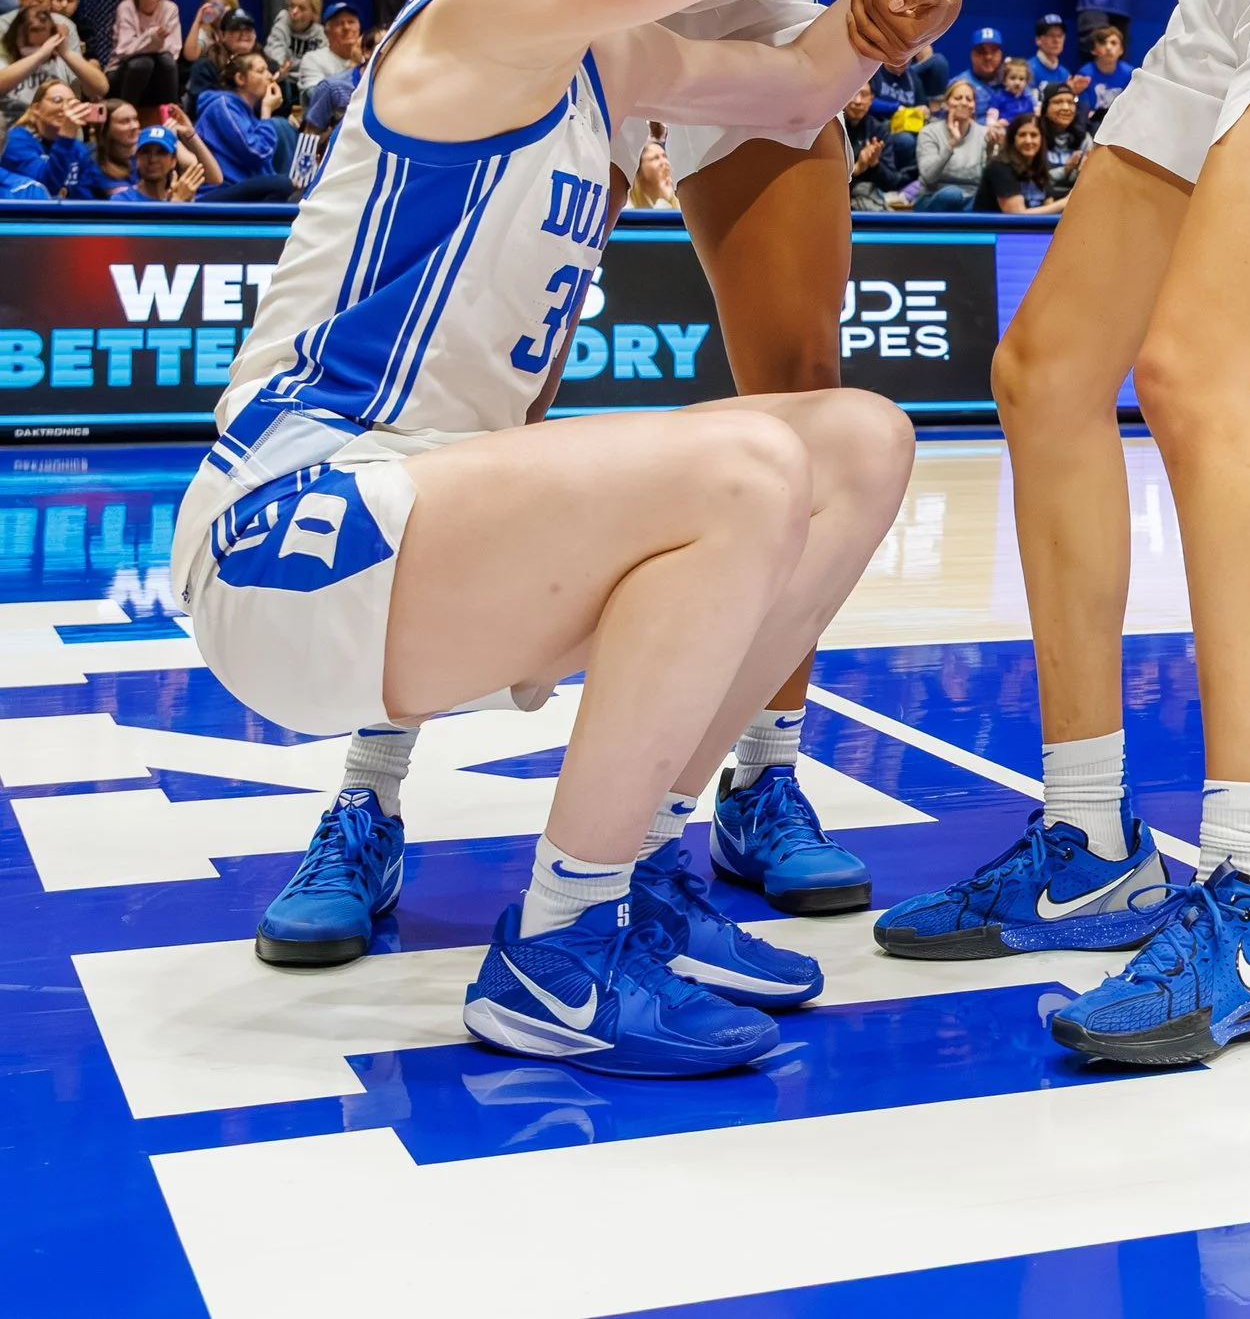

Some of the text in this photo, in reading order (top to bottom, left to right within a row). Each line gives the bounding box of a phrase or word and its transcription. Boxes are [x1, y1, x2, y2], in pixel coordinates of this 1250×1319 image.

[0, 327, 254, 389] BETTE
[561, 323, 711, 381] DRY
[14, 427, 90, 438] DAKTRONICS
